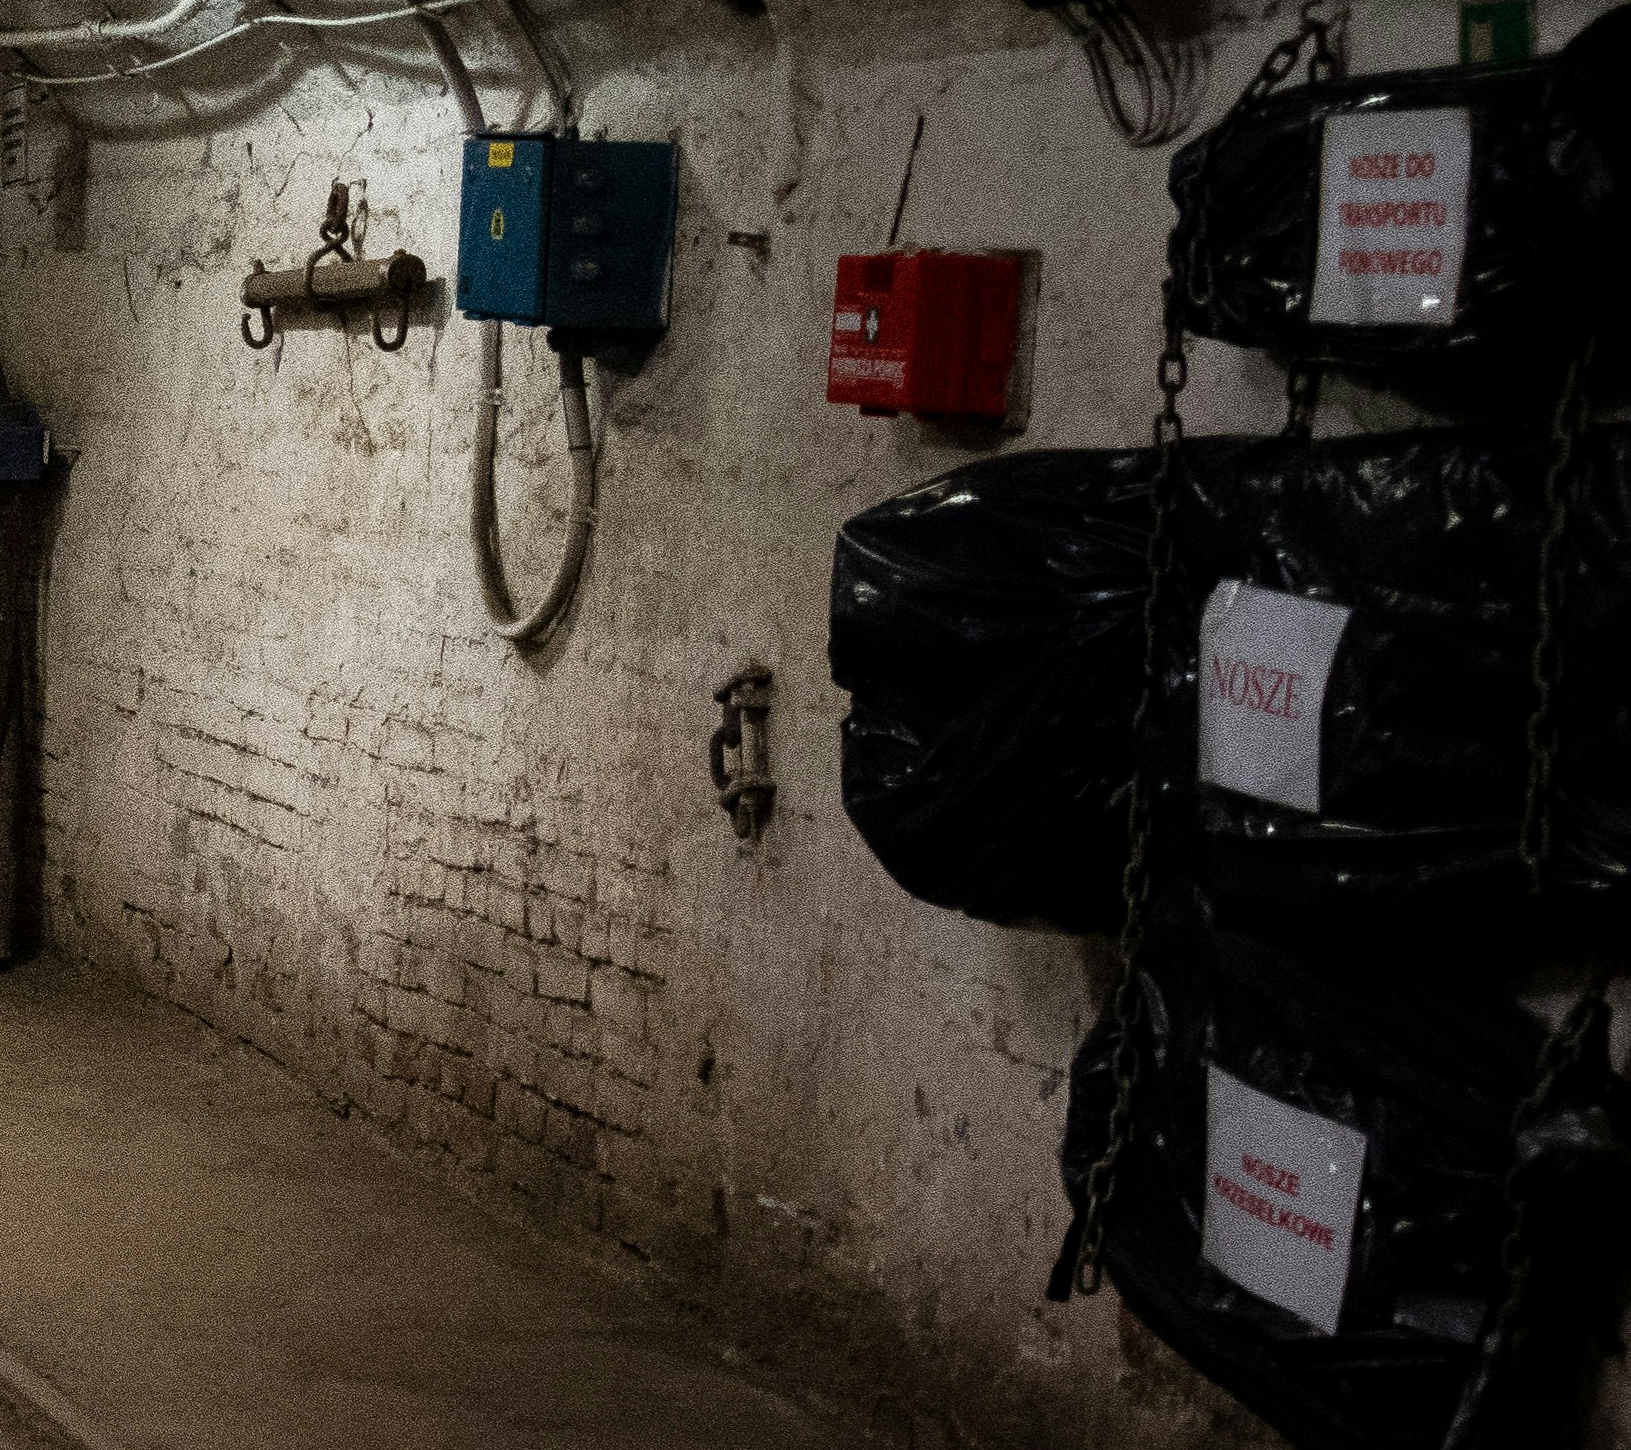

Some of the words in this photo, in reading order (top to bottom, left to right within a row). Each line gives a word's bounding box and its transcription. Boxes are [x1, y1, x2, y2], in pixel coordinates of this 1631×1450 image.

[1406, 153, 1434, 178] DO
[1210, 655, 1302, 720] NOSZE
[1241, 1154, 1300, 1196] NOSZE
